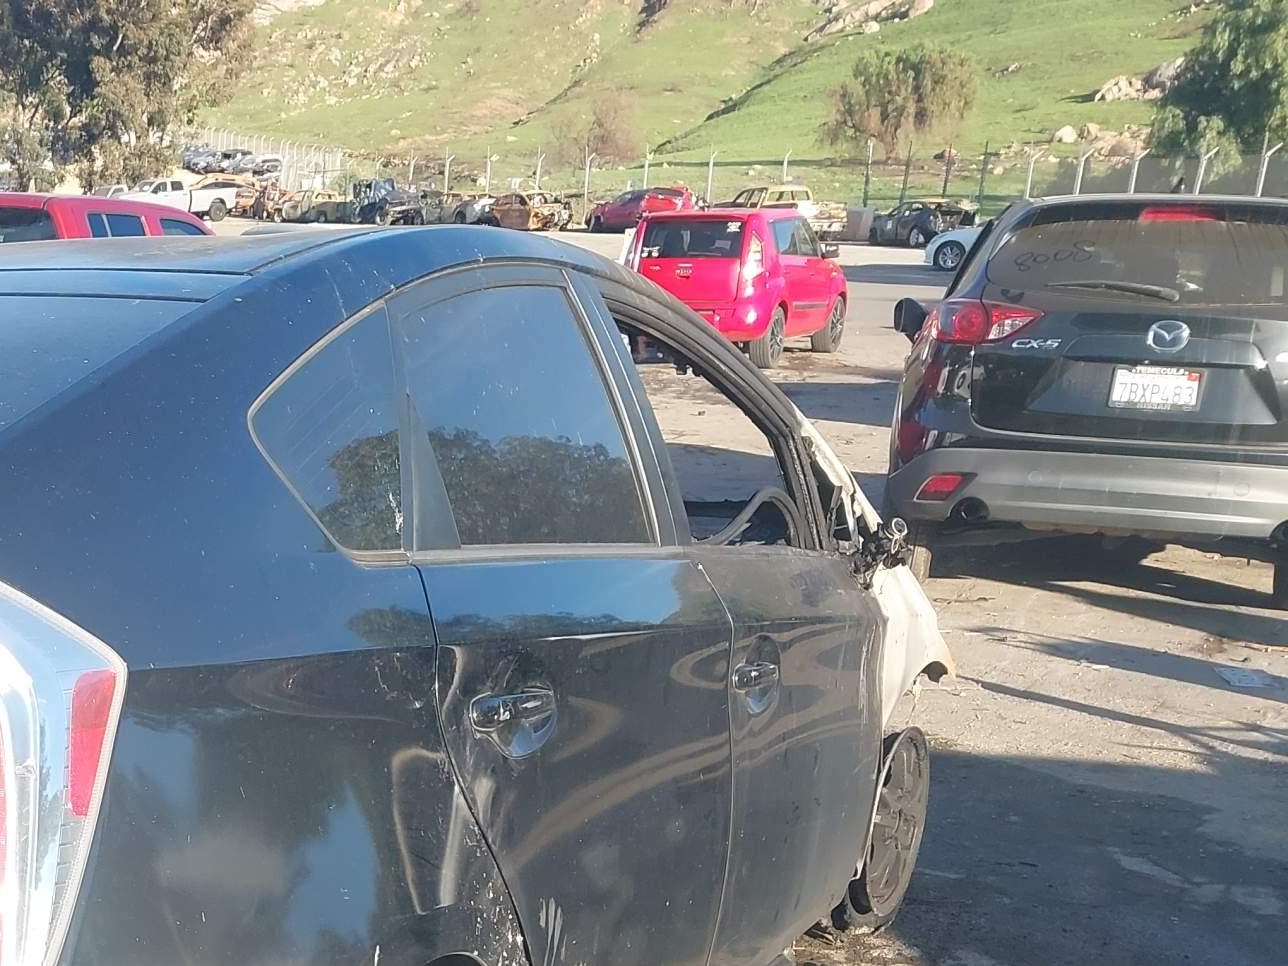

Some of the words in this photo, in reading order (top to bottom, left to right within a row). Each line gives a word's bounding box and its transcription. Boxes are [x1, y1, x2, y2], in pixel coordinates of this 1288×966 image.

[1014, 240, 1096, 272] 8008
[1012, 339, 1062, 349] CX-5
[1119, 382, 1195, 404] 7BXP483
